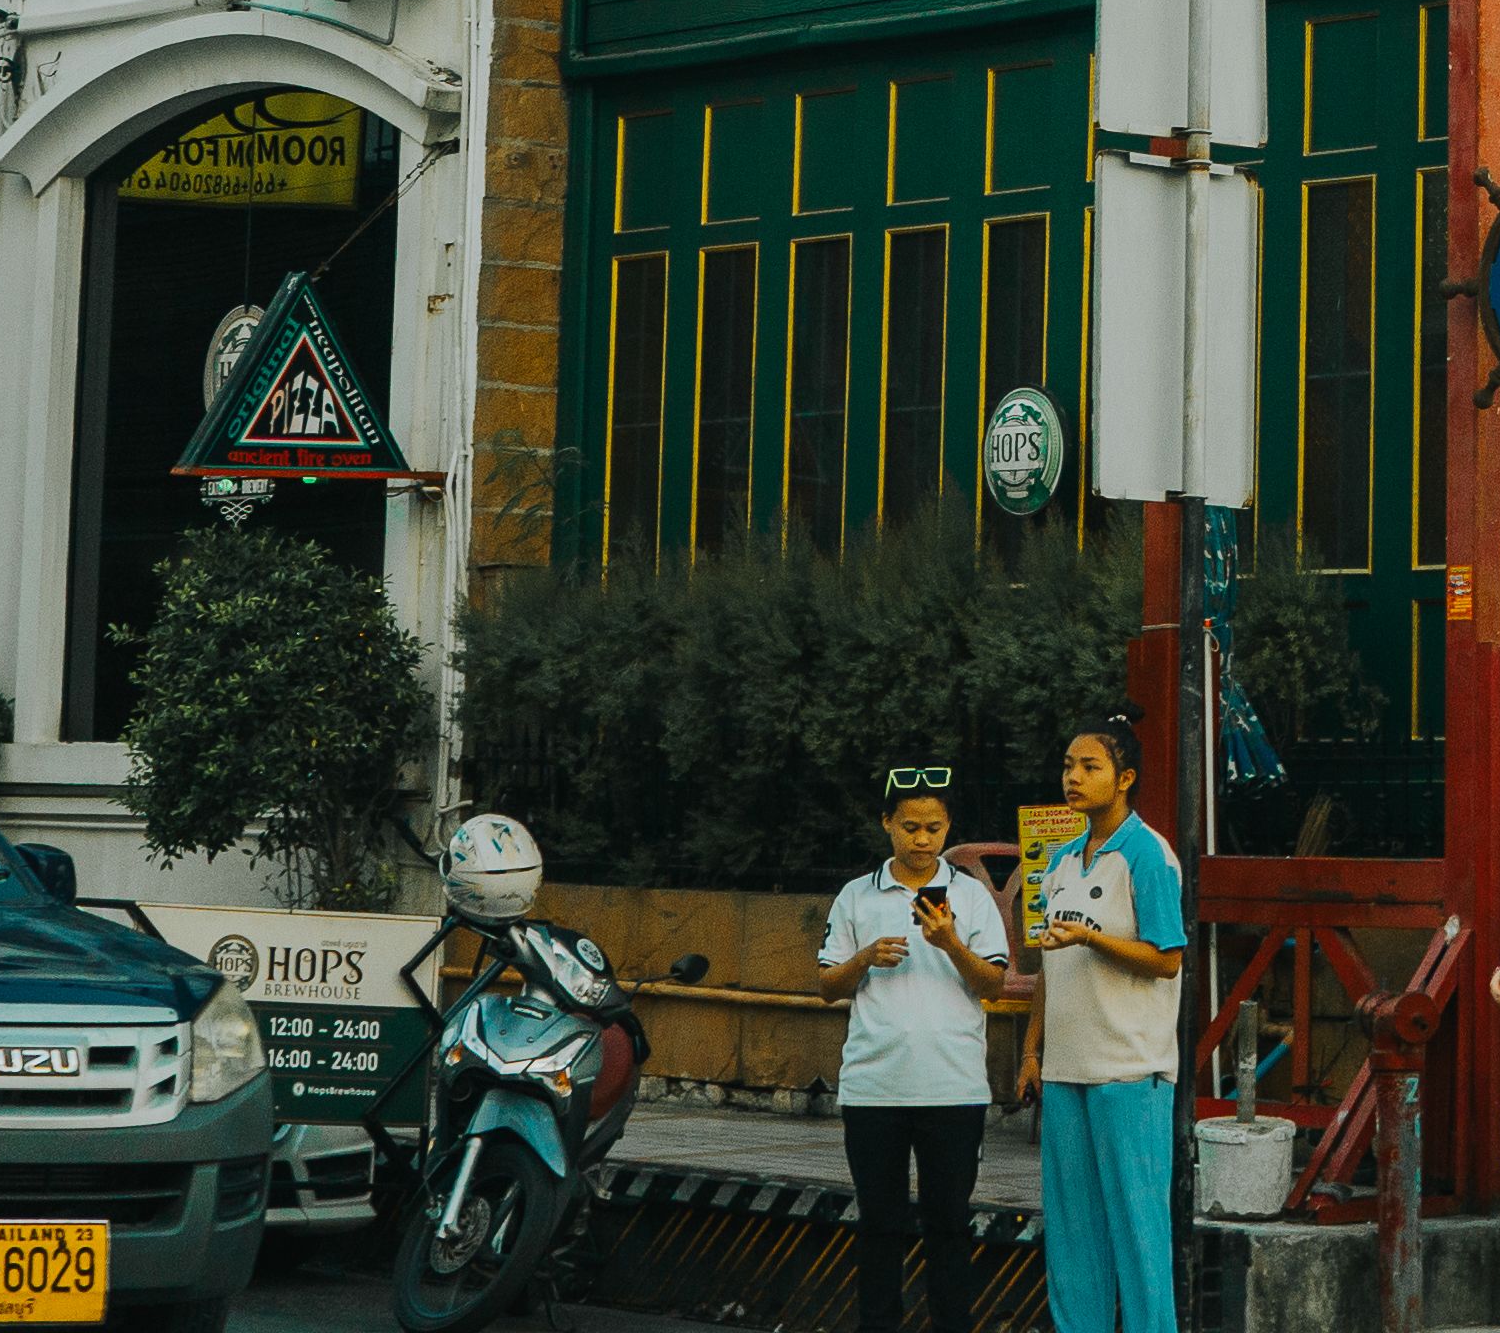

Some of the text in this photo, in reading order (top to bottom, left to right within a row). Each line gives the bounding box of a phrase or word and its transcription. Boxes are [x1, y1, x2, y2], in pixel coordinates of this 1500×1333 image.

[227, 315, 301, 439] original
[308, 319, 382, 446] neapolitan
[269, 370, 341, 435] PIZZA
[227, 447, 373, 468] ancient fire oven
[991, 431, 1042, 463] HOPS
[212, 945, 368, 986] HOPS HOPS
[263, 983, 363, 1001] BREWHOUSE
[269, 1016, 315, 1038] 12:00
[332, 1018, 381, 1041] 24:00
[267, 1048, 312, 1069] 16:00
[330, 1050, 379, 1072] 24:00
[75, 1228, 95, 1242] 23
